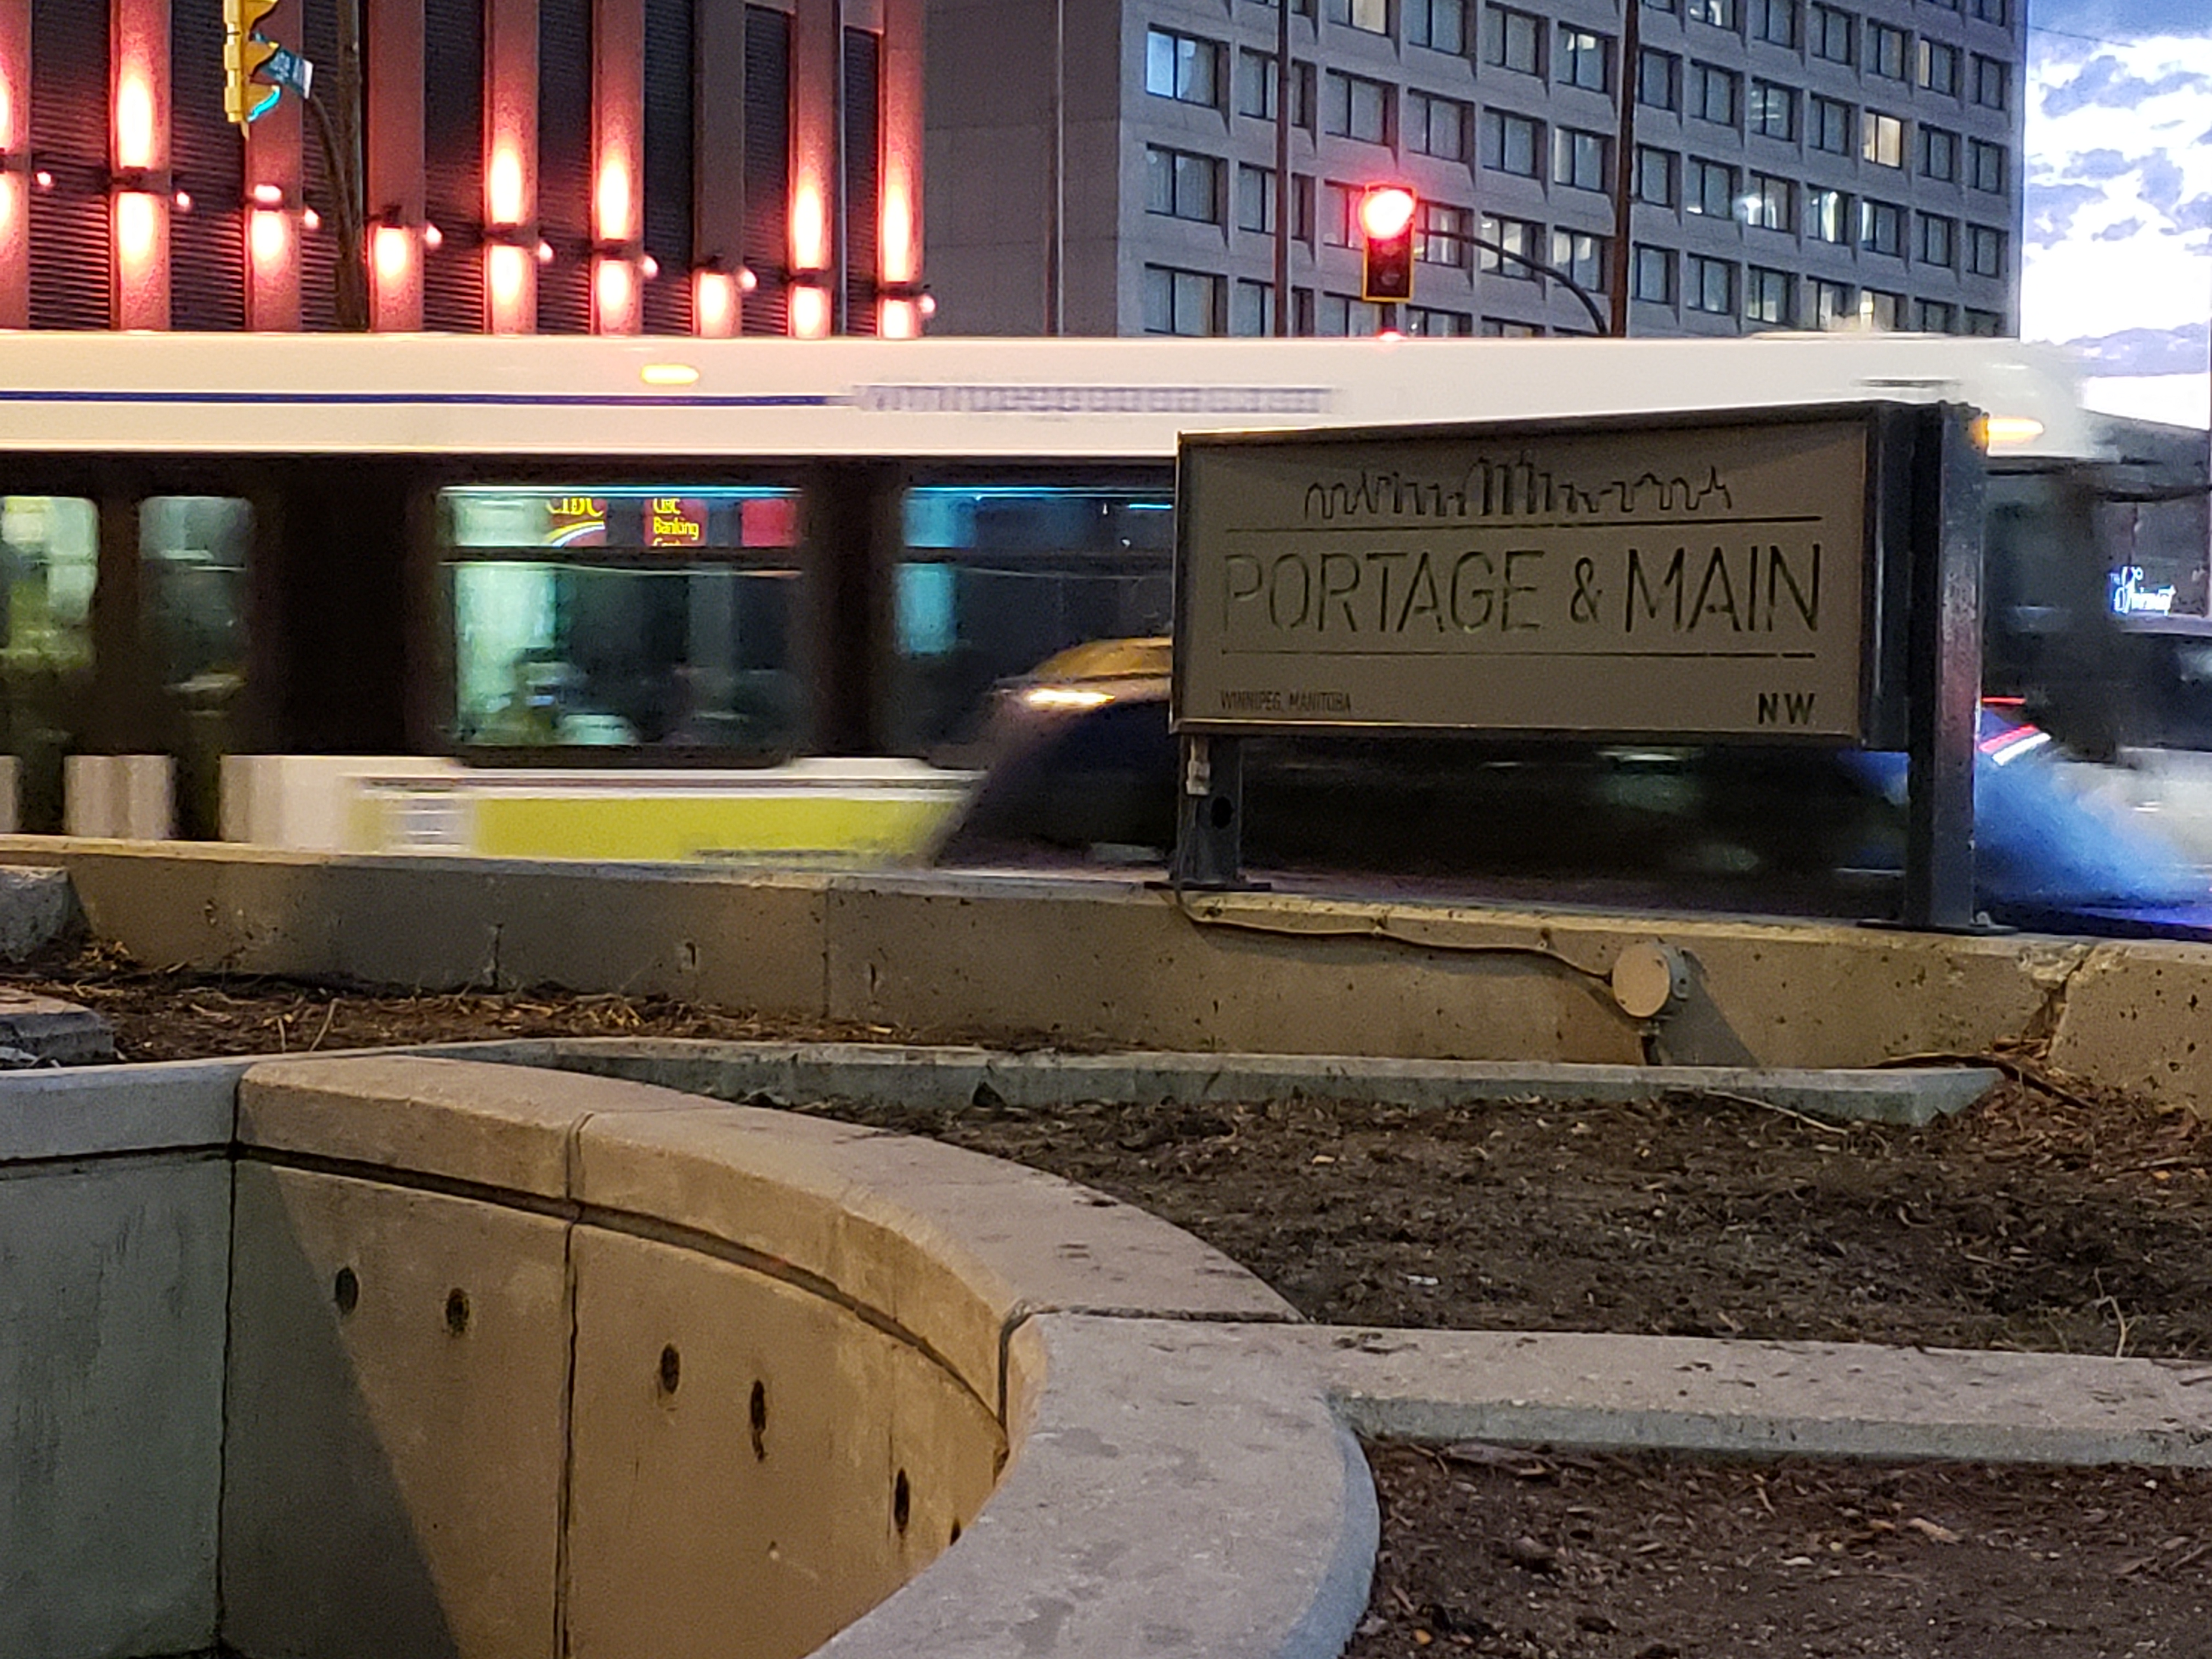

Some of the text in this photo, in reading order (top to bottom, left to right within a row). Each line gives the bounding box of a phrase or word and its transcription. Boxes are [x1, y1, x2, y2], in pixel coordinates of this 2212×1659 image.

[653, 516, 700, 541] Banking
[1223, 543, 1821, 633] PORTAGE & MAIN
[1289, 691, 1352, 713] MANITOBA
[1758, 692, 1815, 725] NW
